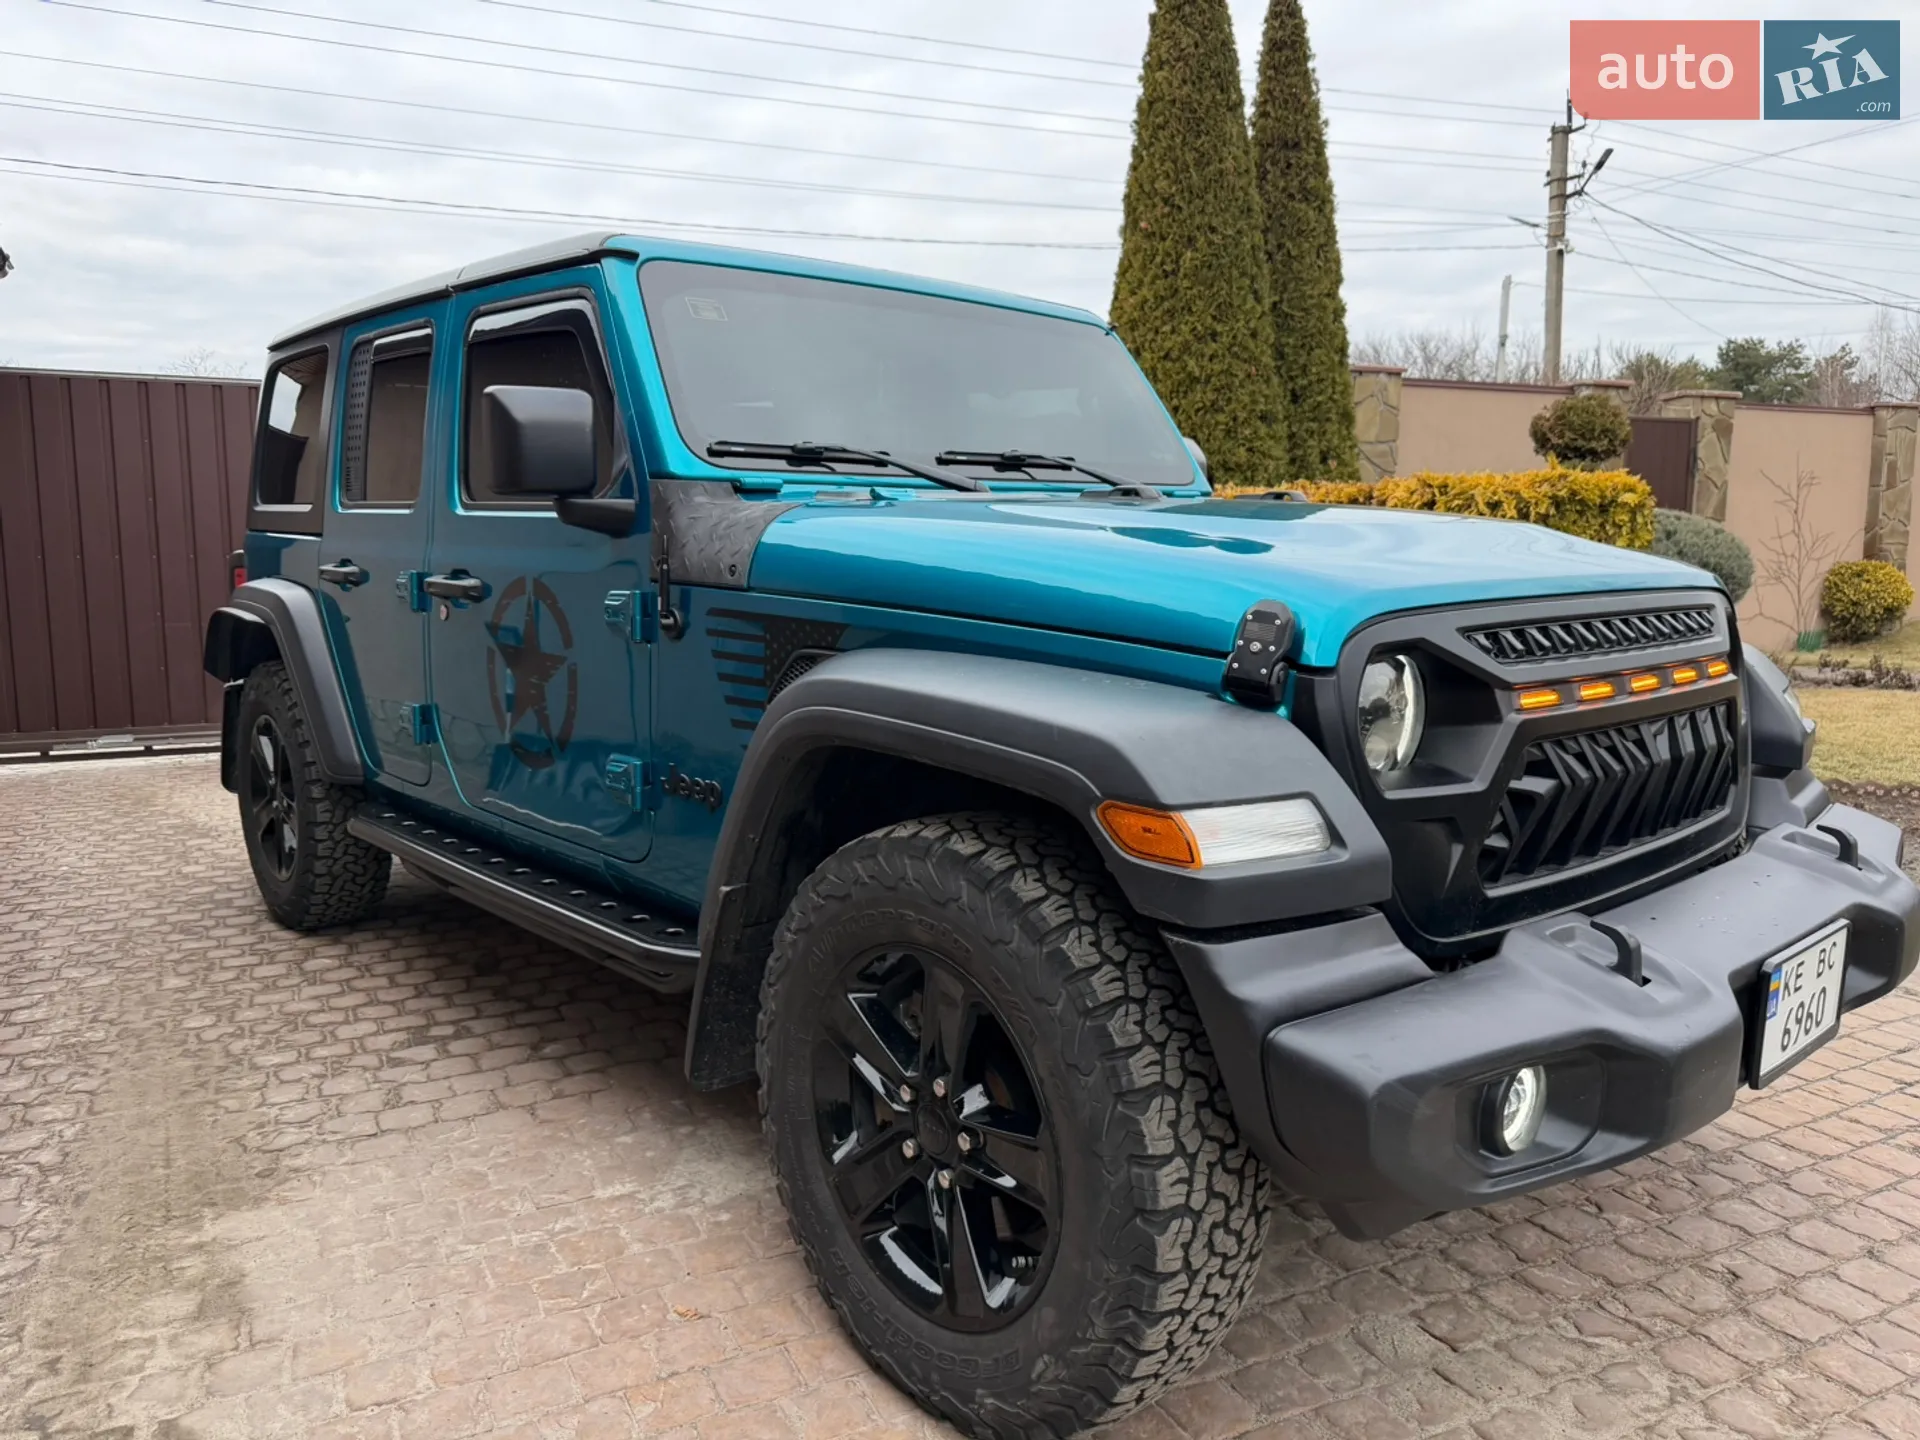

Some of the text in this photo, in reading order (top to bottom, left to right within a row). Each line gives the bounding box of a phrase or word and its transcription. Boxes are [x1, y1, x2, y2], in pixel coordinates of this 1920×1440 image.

[660, 762, 722, 815] Jeep
[1781, 941, 1838, 1001] KE BC
[1780, 986, 1827, 1052] 6960
